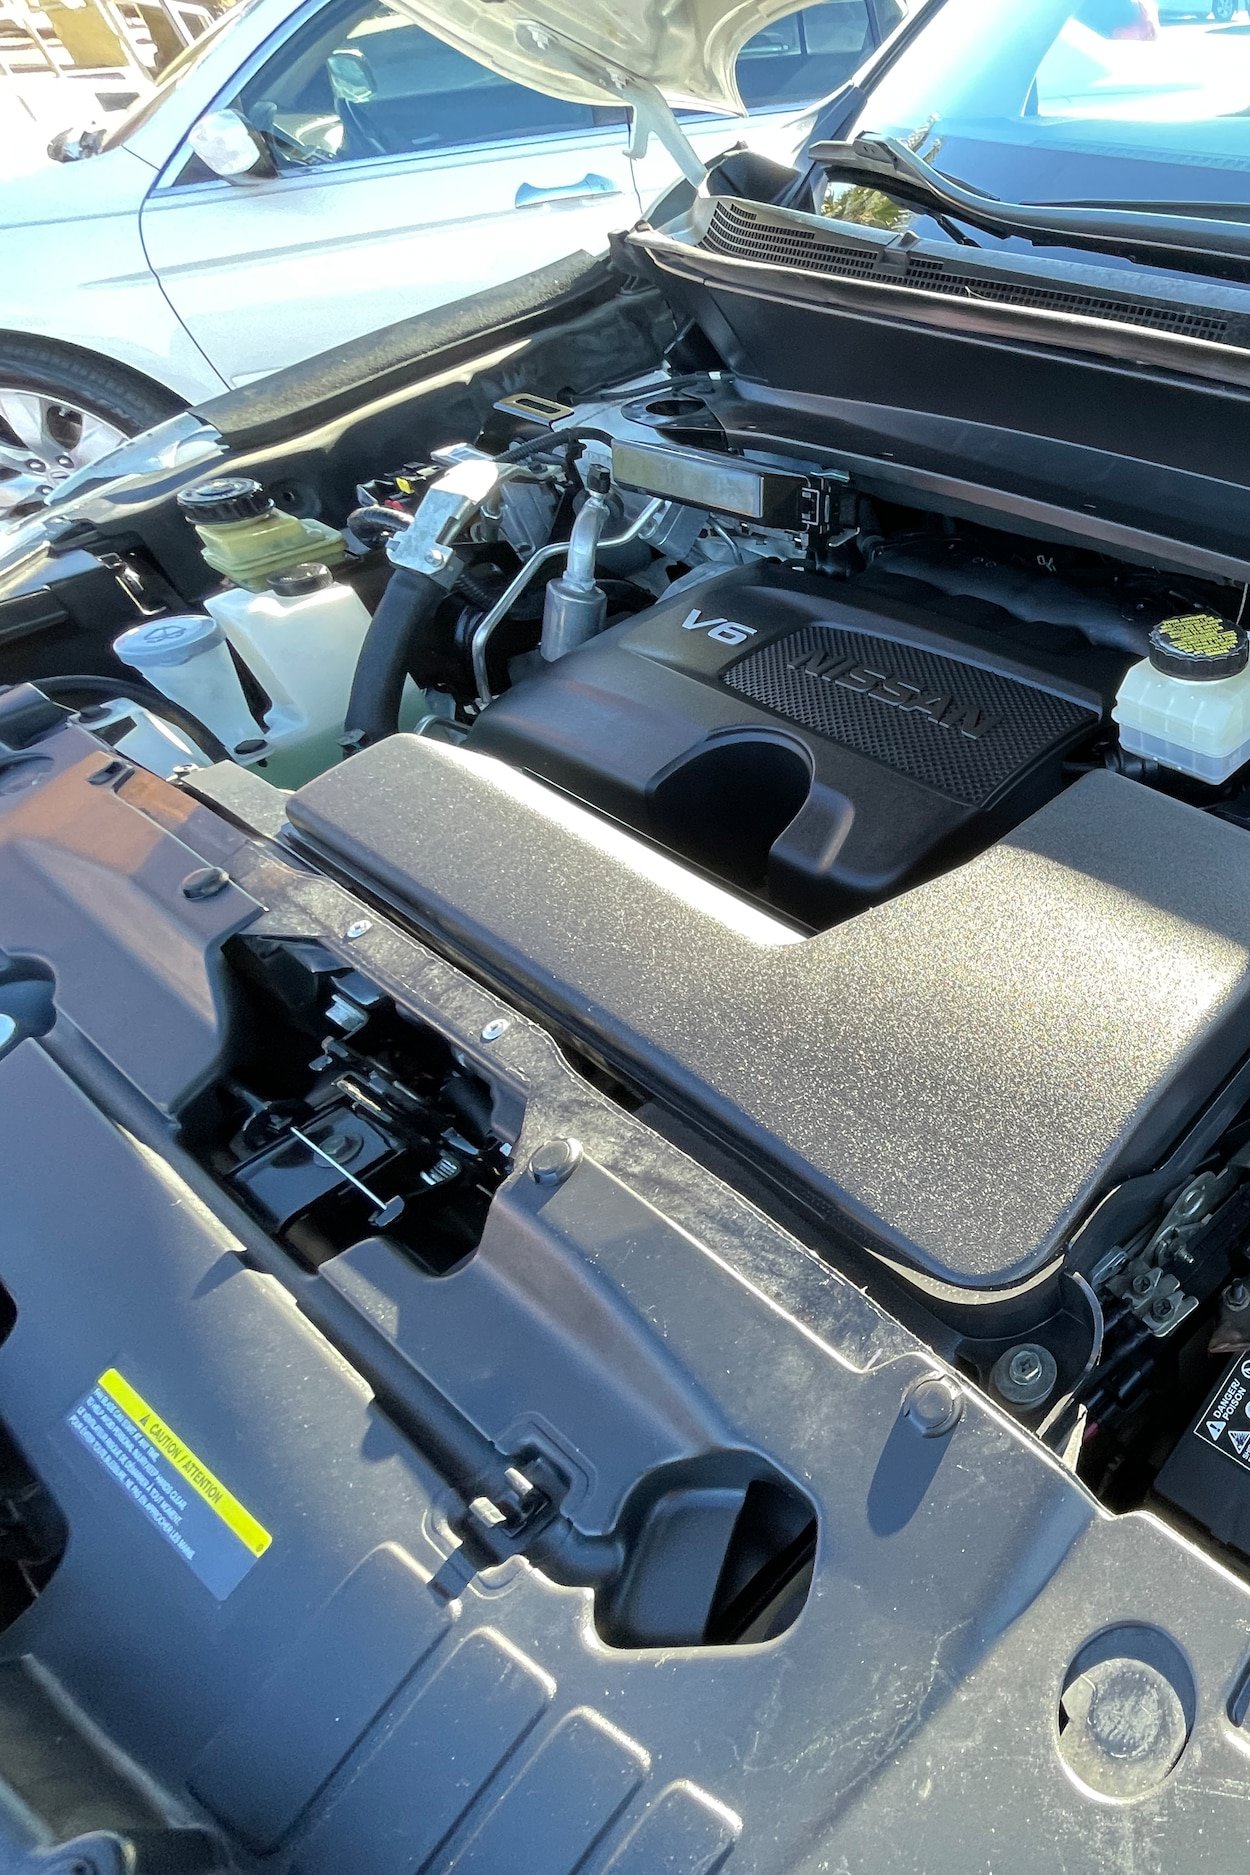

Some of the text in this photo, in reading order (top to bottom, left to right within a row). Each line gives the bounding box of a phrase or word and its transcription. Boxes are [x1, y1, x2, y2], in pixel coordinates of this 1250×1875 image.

[682, 608, 758, 646] V6
[787, 650, 998, 739] NISSAN
[1212, 1377, 1240, 1419] DANGER/
[1221, 1386, 1246, 1421] POISON
[147, 1422, 183, 1459] CAUTION
[180, 1458, 224, 1504] ATTENTION
